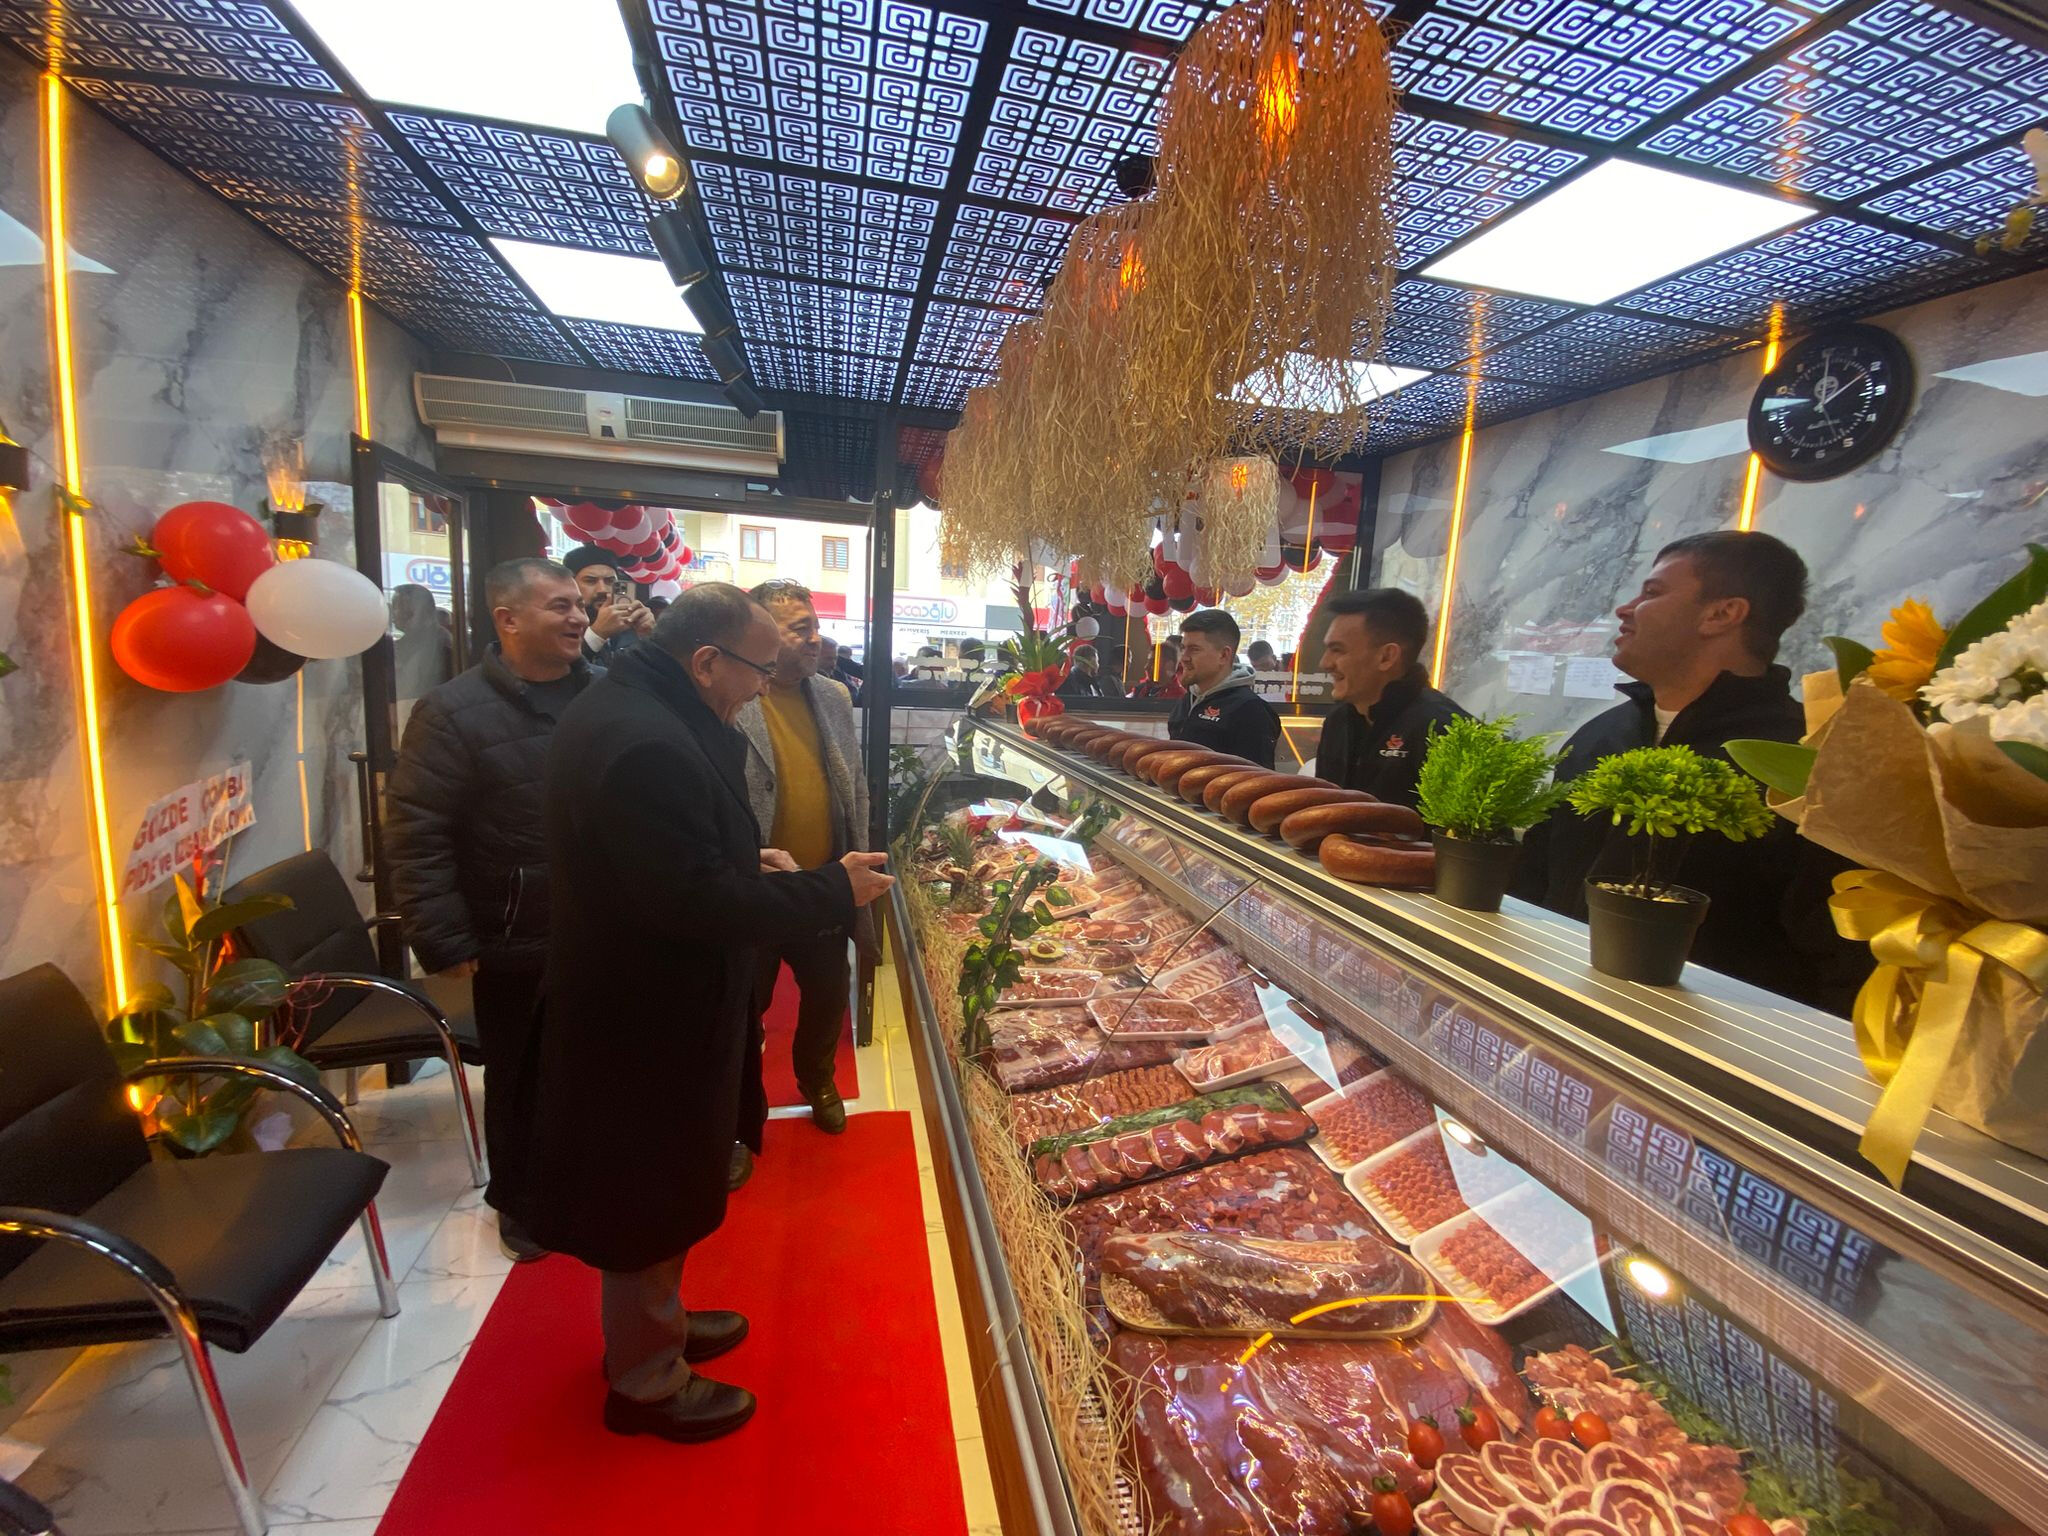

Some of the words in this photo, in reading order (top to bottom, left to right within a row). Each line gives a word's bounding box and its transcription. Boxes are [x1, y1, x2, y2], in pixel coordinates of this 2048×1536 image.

[1870, 361, 1881, 371] 2
[1874, 385, 1886, 396] 3
[1768, 412, 1778, 421] 9
[1866, 413, 1877, 422] 4
[1843, 438, 1854, 447] 5
[1790, 449, 1800, 458] 7
[1815, 450, 1826, 459] 6
[893, 602, 954, 623] ocaoğlu
